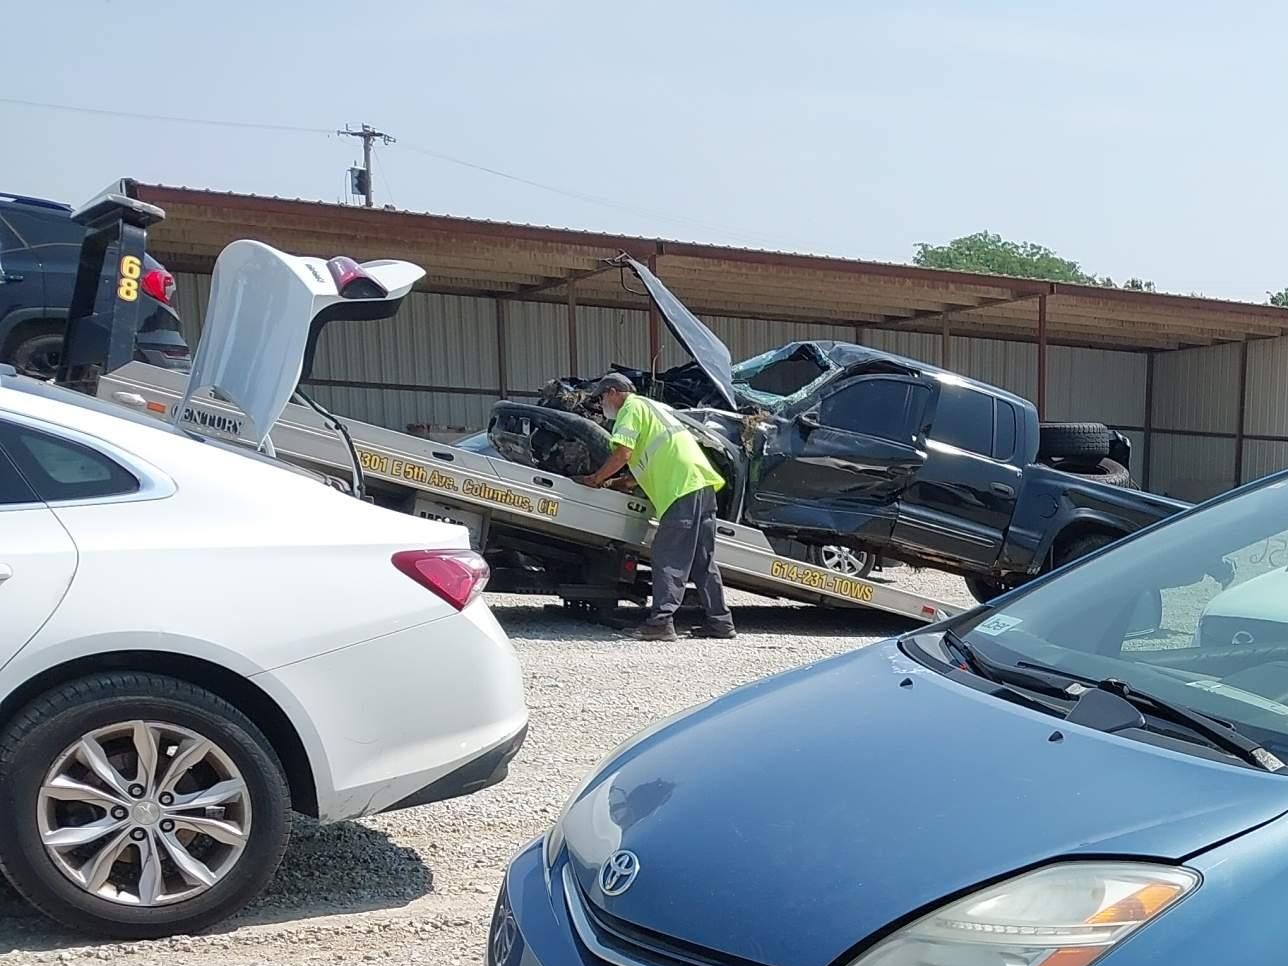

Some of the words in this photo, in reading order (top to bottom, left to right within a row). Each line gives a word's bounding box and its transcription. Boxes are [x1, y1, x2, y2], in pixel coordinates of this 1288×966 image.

[118, 255, 141, 301] 68
[390, 461, 402, 477] E
[403, 464, 428, 484] 5th
[428, 470, 459, 492] Ave.
[462, 478, 533, 512] Columbus,
[771, 560, 874, 602] 614-231-TOWS
